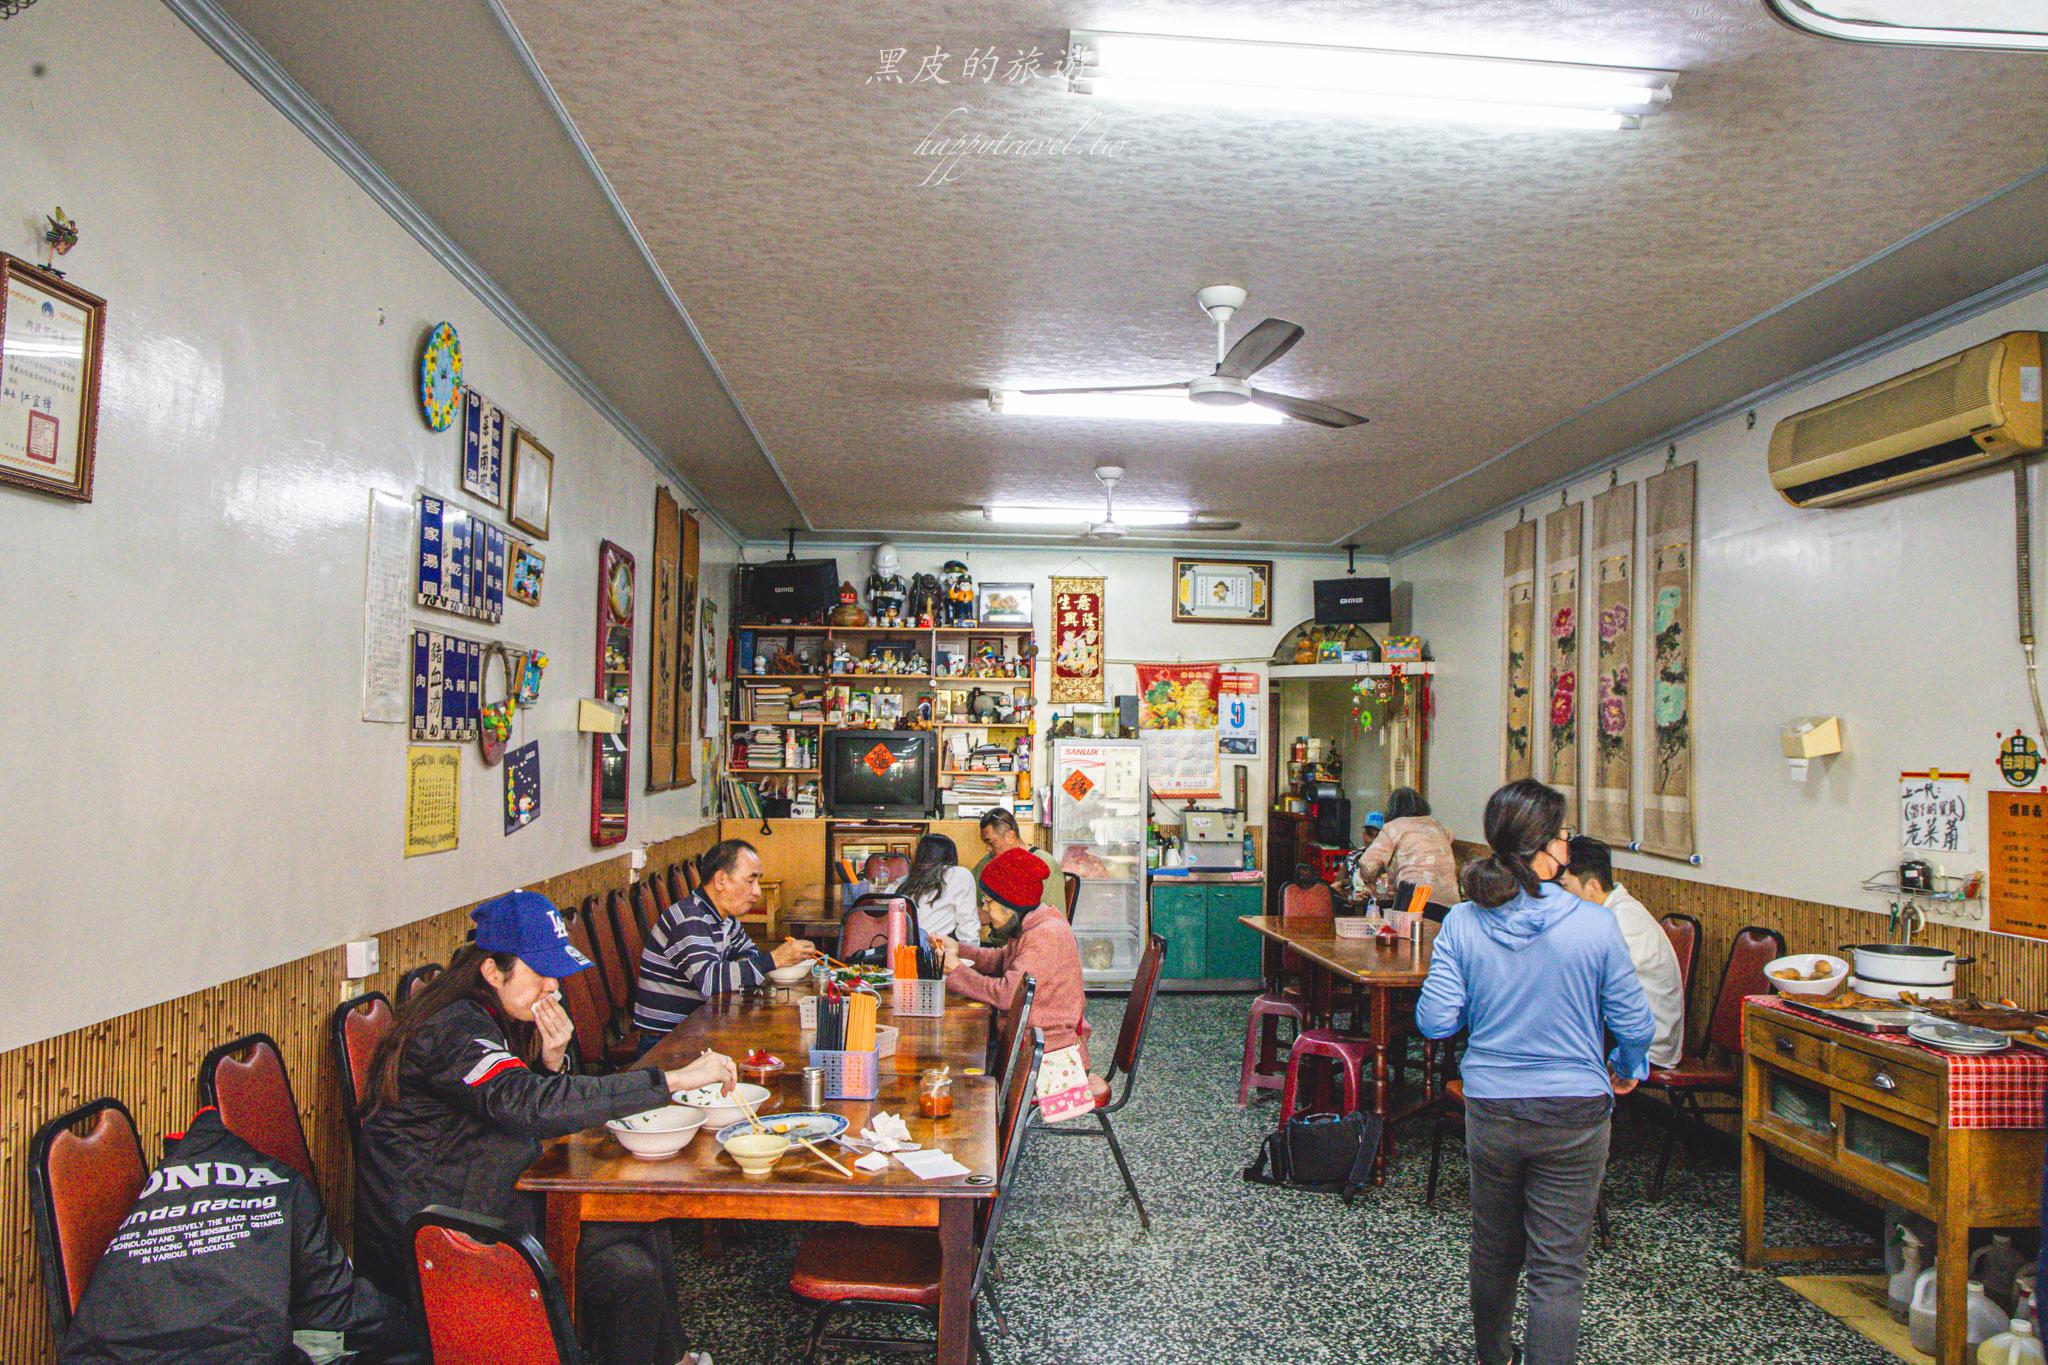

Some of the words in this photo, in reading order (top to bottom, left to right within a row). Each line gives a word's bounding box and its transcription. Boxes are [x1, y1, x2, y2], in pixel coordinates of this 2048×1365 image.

[1230, 701, 1245, 729] 9
[430, 724, 439, 738] 40
[1065, 748, 1100, 756] SANLUX
[190, 1195, 277, 1215] Racing
[207, 1217, 223, 1227] THE
[225, 1214, 247, 1226] RACE
[128, 1246, 154, 1258] FROM
[153, 1242, 183, 1254] RACING
[188, 1238, 204, 1248] ARE
[208, 1231, 250, 1245] REFLECTED
[158, 1234, 176, 1245] AND
[183, 1230, 200, 1240] THE
[142, 1256, 151, 1264] IN
[152, 1250, 187, 1263] VARIOUS
